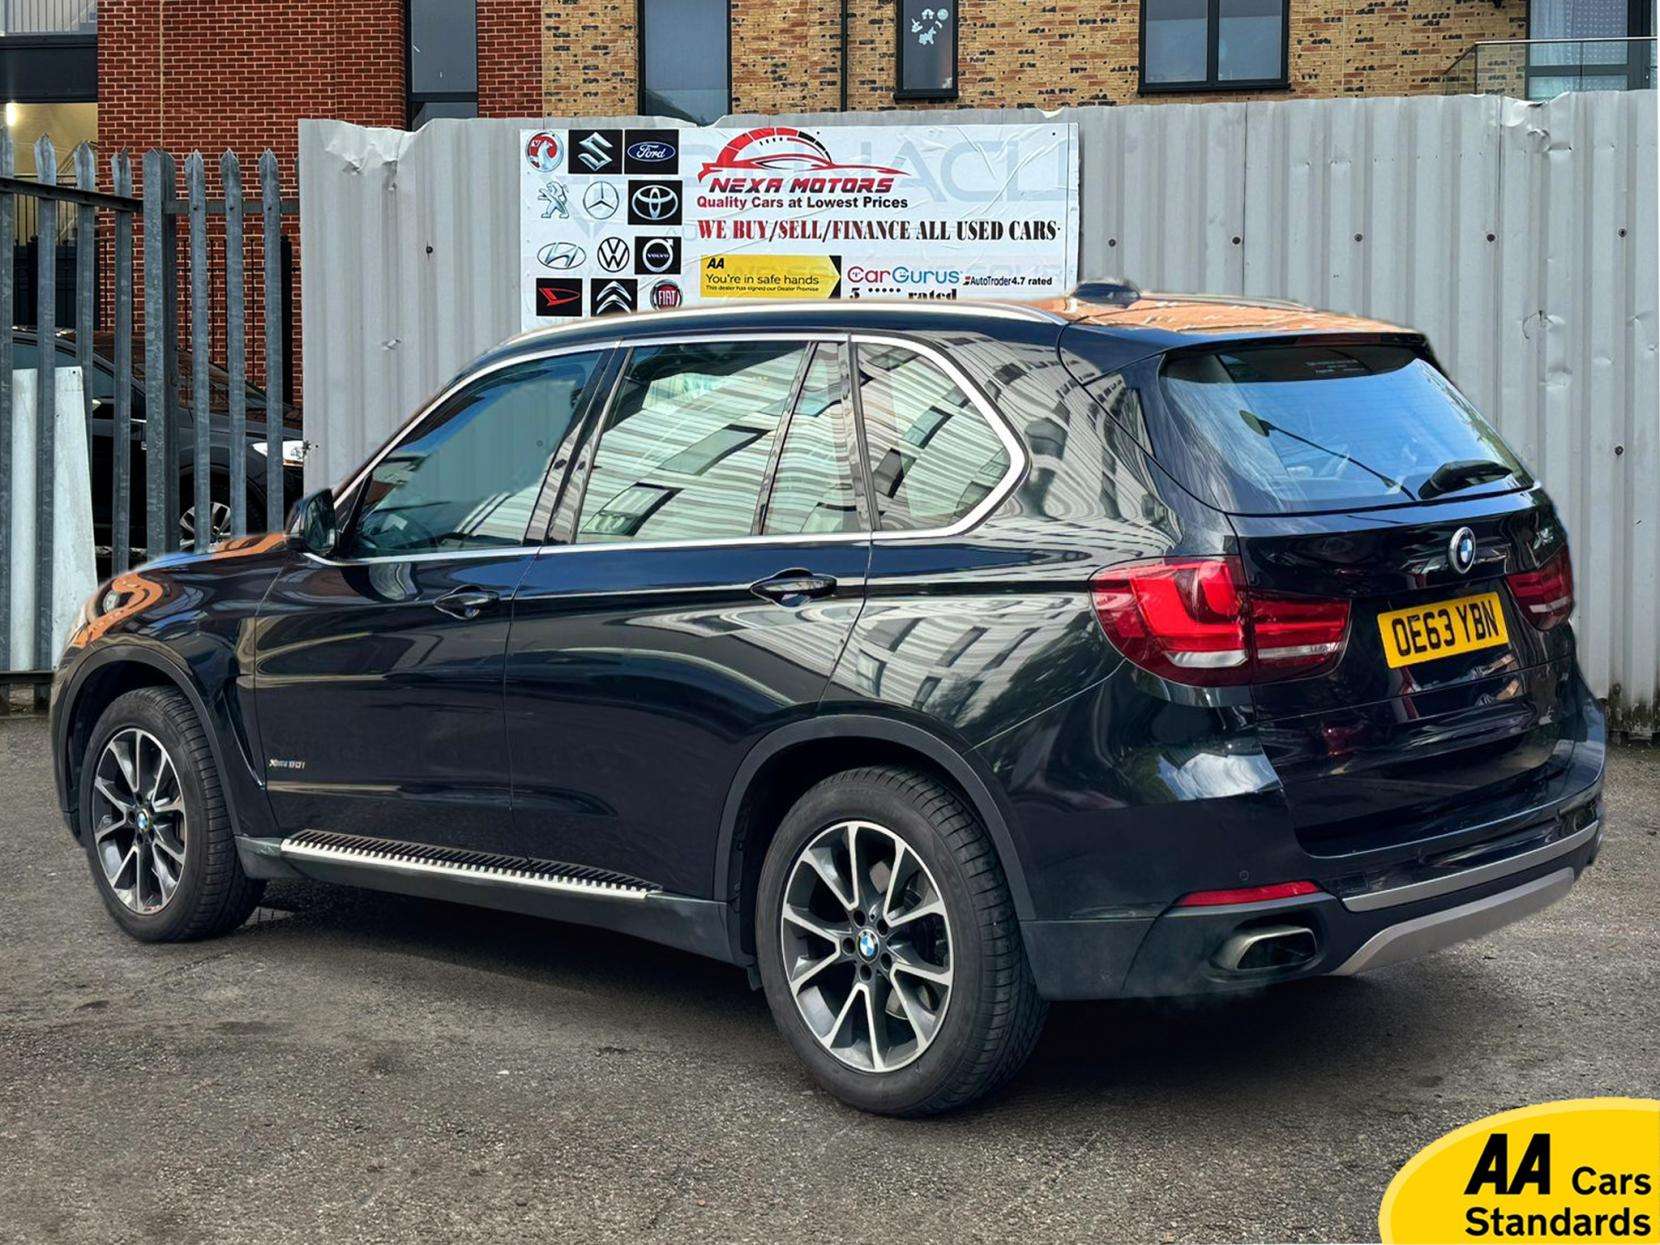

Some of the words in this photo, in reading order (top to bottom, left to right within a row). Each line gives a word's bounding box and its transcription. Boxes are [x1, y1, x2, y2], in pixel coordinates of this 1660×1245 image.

[636, 144, 667, 158] Ford
[709, 178, 784, 194] NEXA
[789, 178, 895, 194] MOTORS
[696, 195, 747, 210] Quality
[751, 196, 784, 209] Cars
[788, 196, 803, 209] at
[807, 196, 859, 209] Lowest
[863, 196, 908, 209] Prices
[697, 219, 727, 240] WE
[733, 219, 911, 243] BUY/SELL/FINANCE
[916, 220, 951, 241] ALL
[956, 220, 1004, 241] USED
[706, 257, 725, 269] AA
[706, 273, 741, 284] You're
[743, 273, 754, 284] in
[757, 274, 781, 285] safe
[784, 275, 819, 285] hands
[847, 266, 960, 283] CarGurus
[970, 276, 1011, 286] AutoTrader
[1011, 277, 1026, 286] 4.7
[1028, 277, 1053, 286] rated
[658, 290, 677, 306] FIAT
[849, 287, 861, 299] 5
[1391, 608, 1456, 656] OE63
[1456, 599, 1500, 643] YBN
